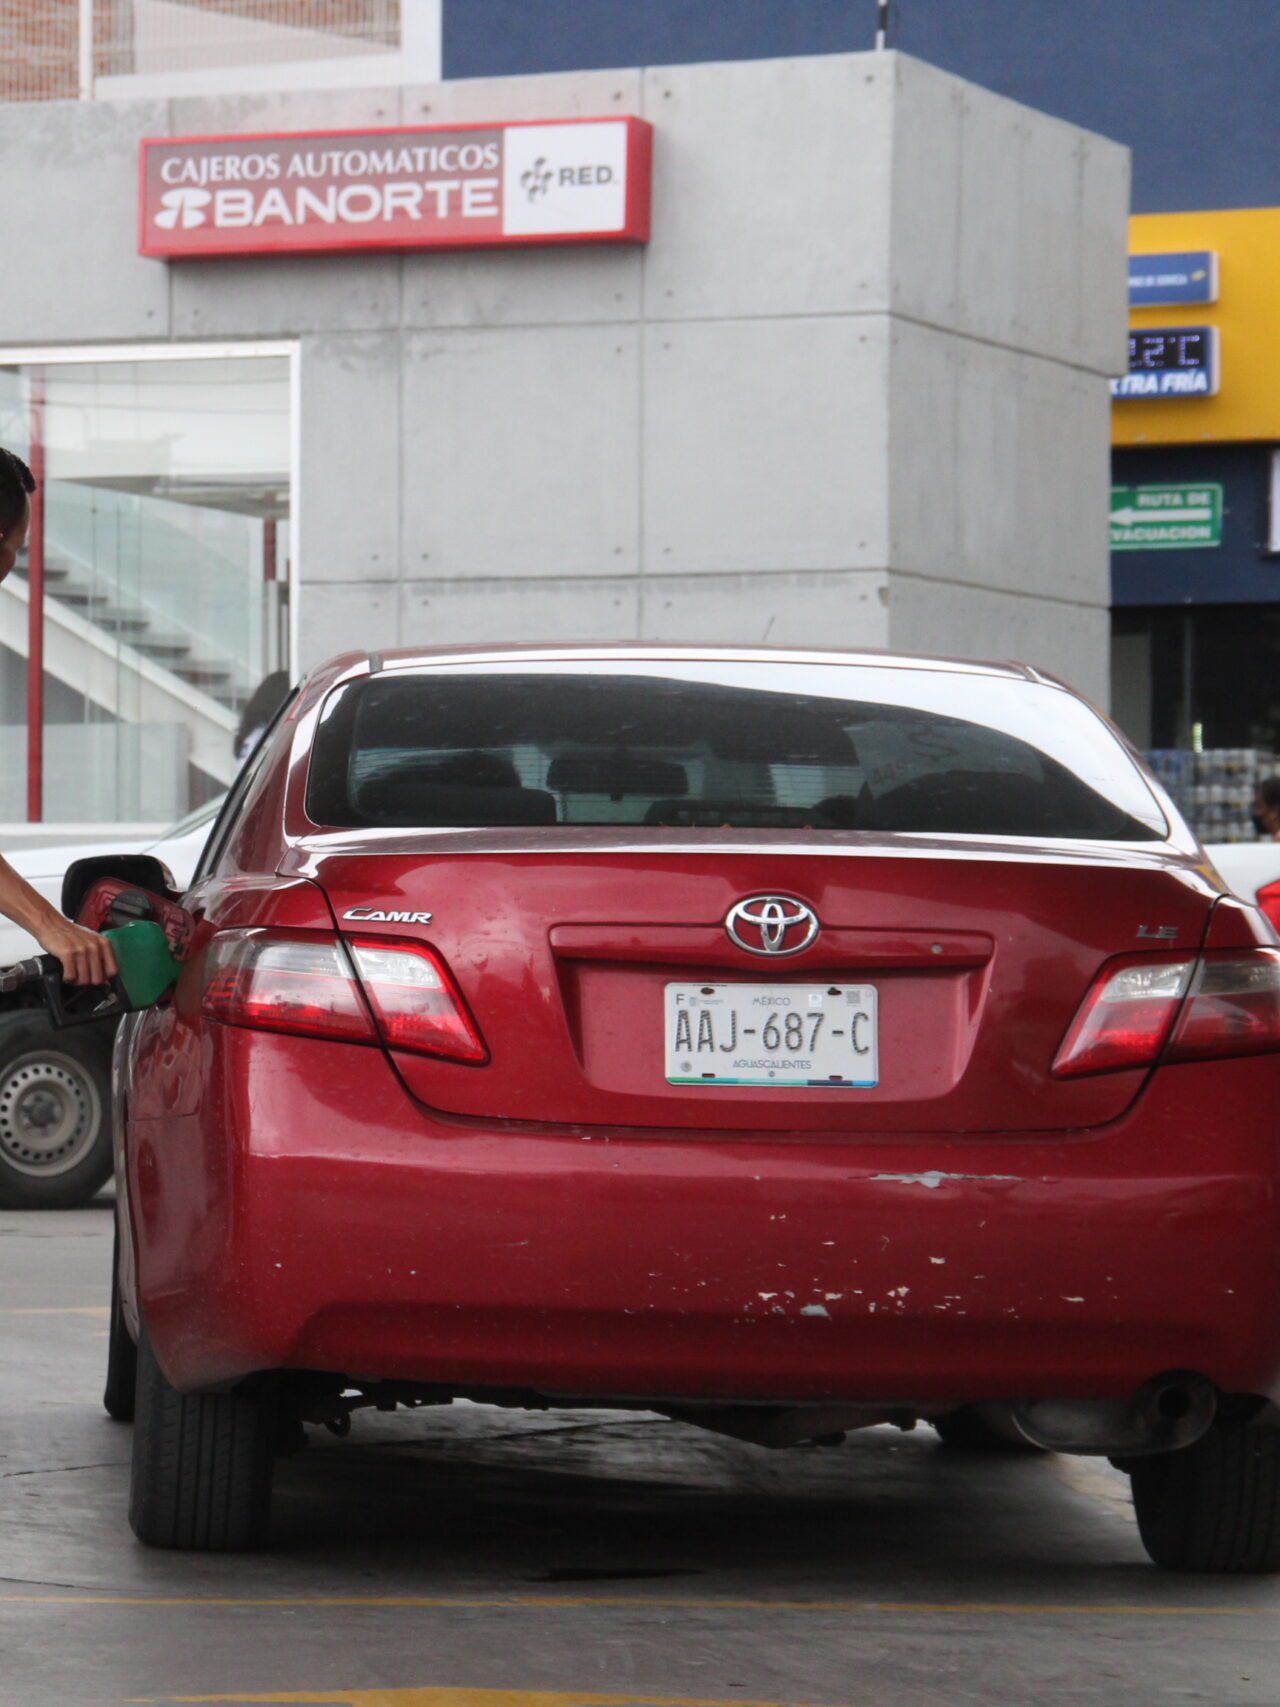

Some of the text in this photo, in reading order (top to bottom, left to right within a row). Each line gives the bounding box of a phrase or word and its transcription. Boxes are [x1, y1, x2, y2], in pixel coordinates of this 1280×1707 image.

[160, 143, 499, 187] CAJEROS AUTOMATICOS
[558, 165, 613, 187] RED
[213, 178, 499, 228] BANORTE
[1136, 490, 1212, 507] RUTA DE
[1110, 525, 1211, 541] VACUACION
[342, 907, 432, 925] CAMR
[751, 996, 791, 1007] MÉXICO
[674, 1009, 870, 1055] AAJ-687-C
[732, 1058, 812, 1070] AGUASCALIENTES
